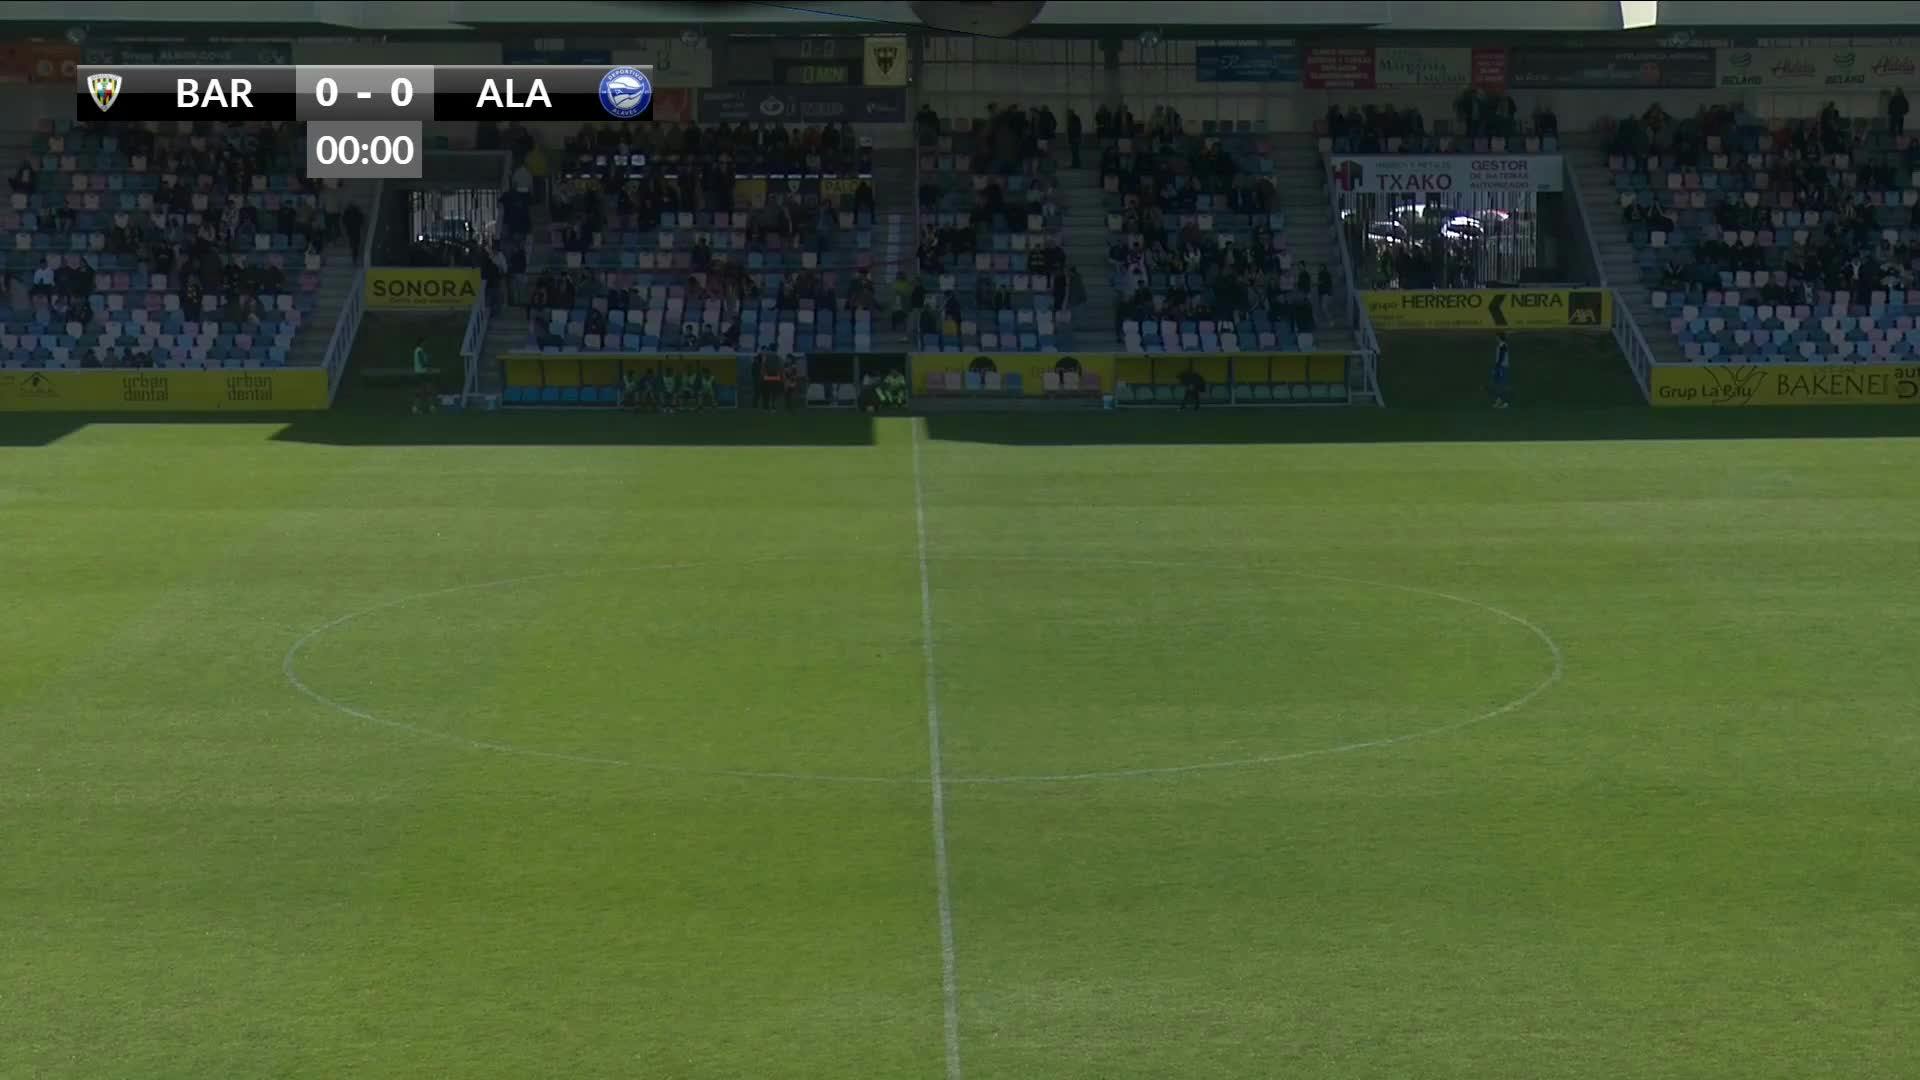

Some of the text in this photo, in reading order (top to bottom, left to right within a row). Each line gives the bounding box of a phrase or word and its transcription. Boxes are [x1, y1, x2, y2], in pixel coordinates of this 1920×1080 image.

[1471, 160, 1528, 171] GESTOR
[1376, 174, 1453, 191] TXAKO
[373, 279, 476, 297] SONORA
[1402, 294, 1482, 309] HERRERO
[1511, 293, 1563, 308] NEIRA
[122, 373, 168, 388] urban
[227, 373, 272, 388] urban
[1659, 384, 1752, 400] Grup La Pau
